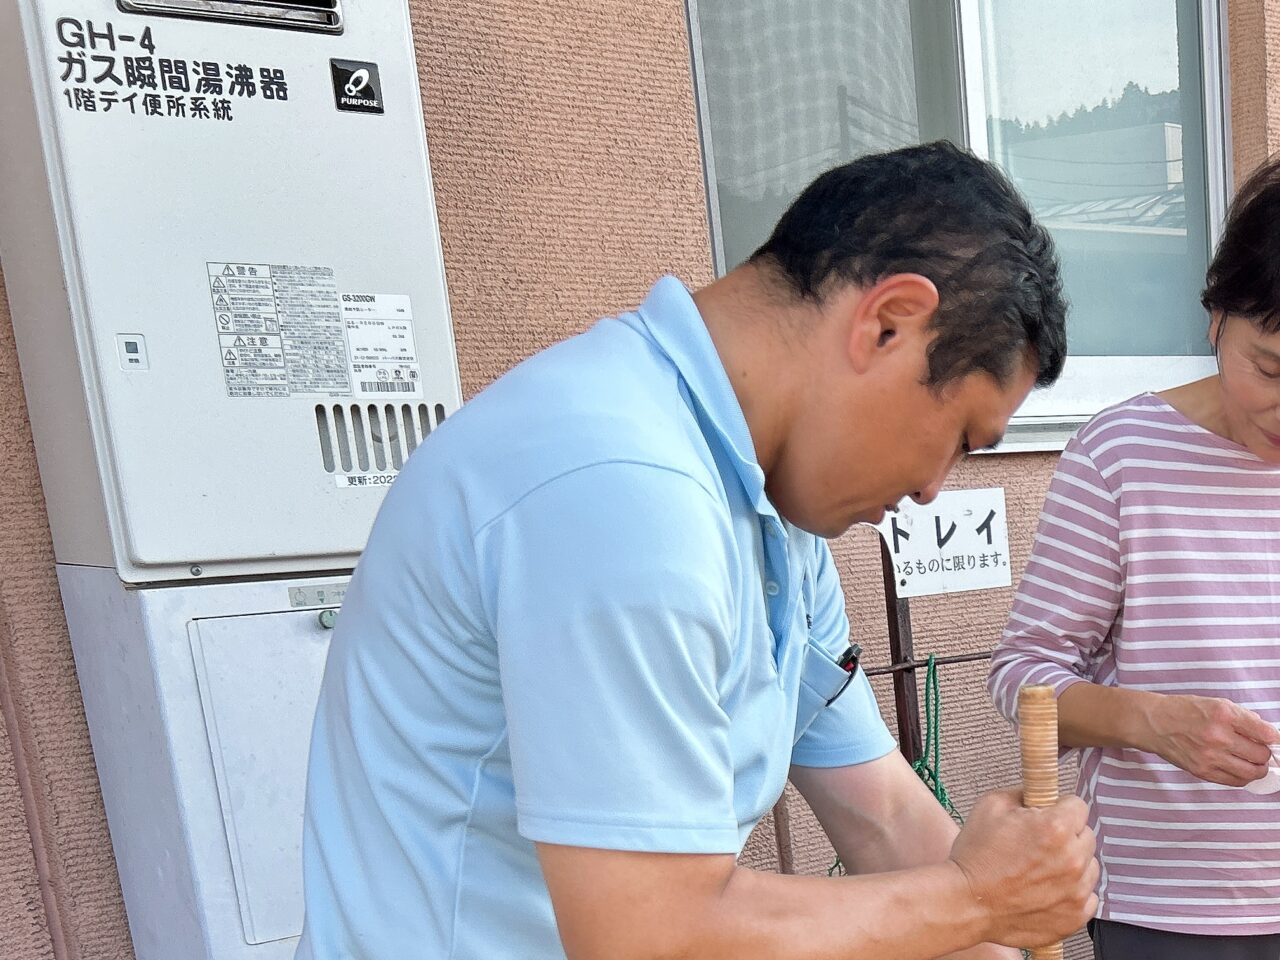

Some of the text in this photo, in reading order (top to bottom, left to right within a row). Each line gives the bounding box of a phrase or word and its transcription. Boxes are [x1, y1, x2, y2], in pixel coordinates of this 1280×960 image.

[56, 17, 156, 54] GH-4
[58, 51, 290, 102] ガス瞬間湯沸器
[64, 88, 235, 121] 1階デイ便所系統
[340, 97, 379, 107] PURPOSE
[236, 265, 258, 276] 警告
[246, 336, 269, 347] 注意
[890, 508, 997, 554] トレイ
